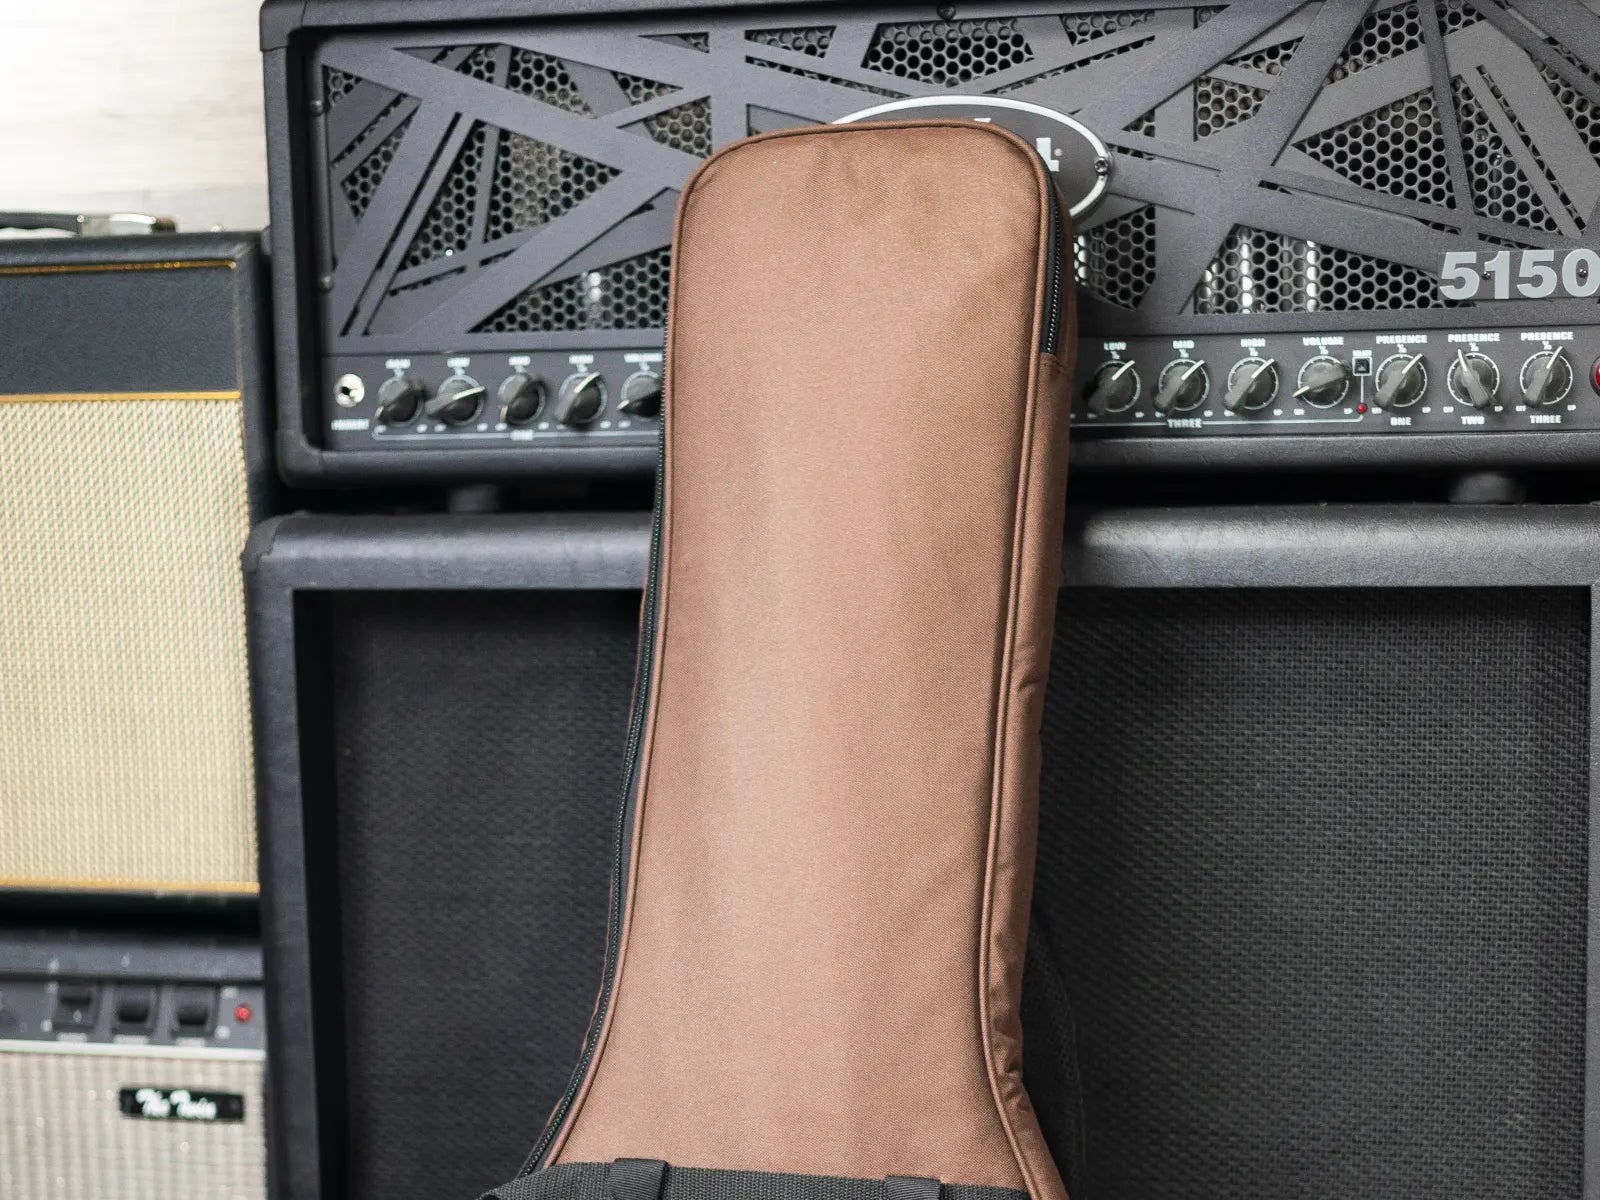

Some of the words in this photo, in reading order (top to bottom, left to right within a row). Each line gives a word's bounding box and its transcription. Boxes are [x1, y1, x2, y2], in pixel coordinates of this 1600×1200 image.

[1439, 248, 1600, 300] 5150
[1375, 334, 1428, 344] PRESENCE
[1447, 333, 1501, 343] PRESENCE
[1520, 331, 1574, 341] PRESENCE
[1529, 414, 1562, 424] THREE
